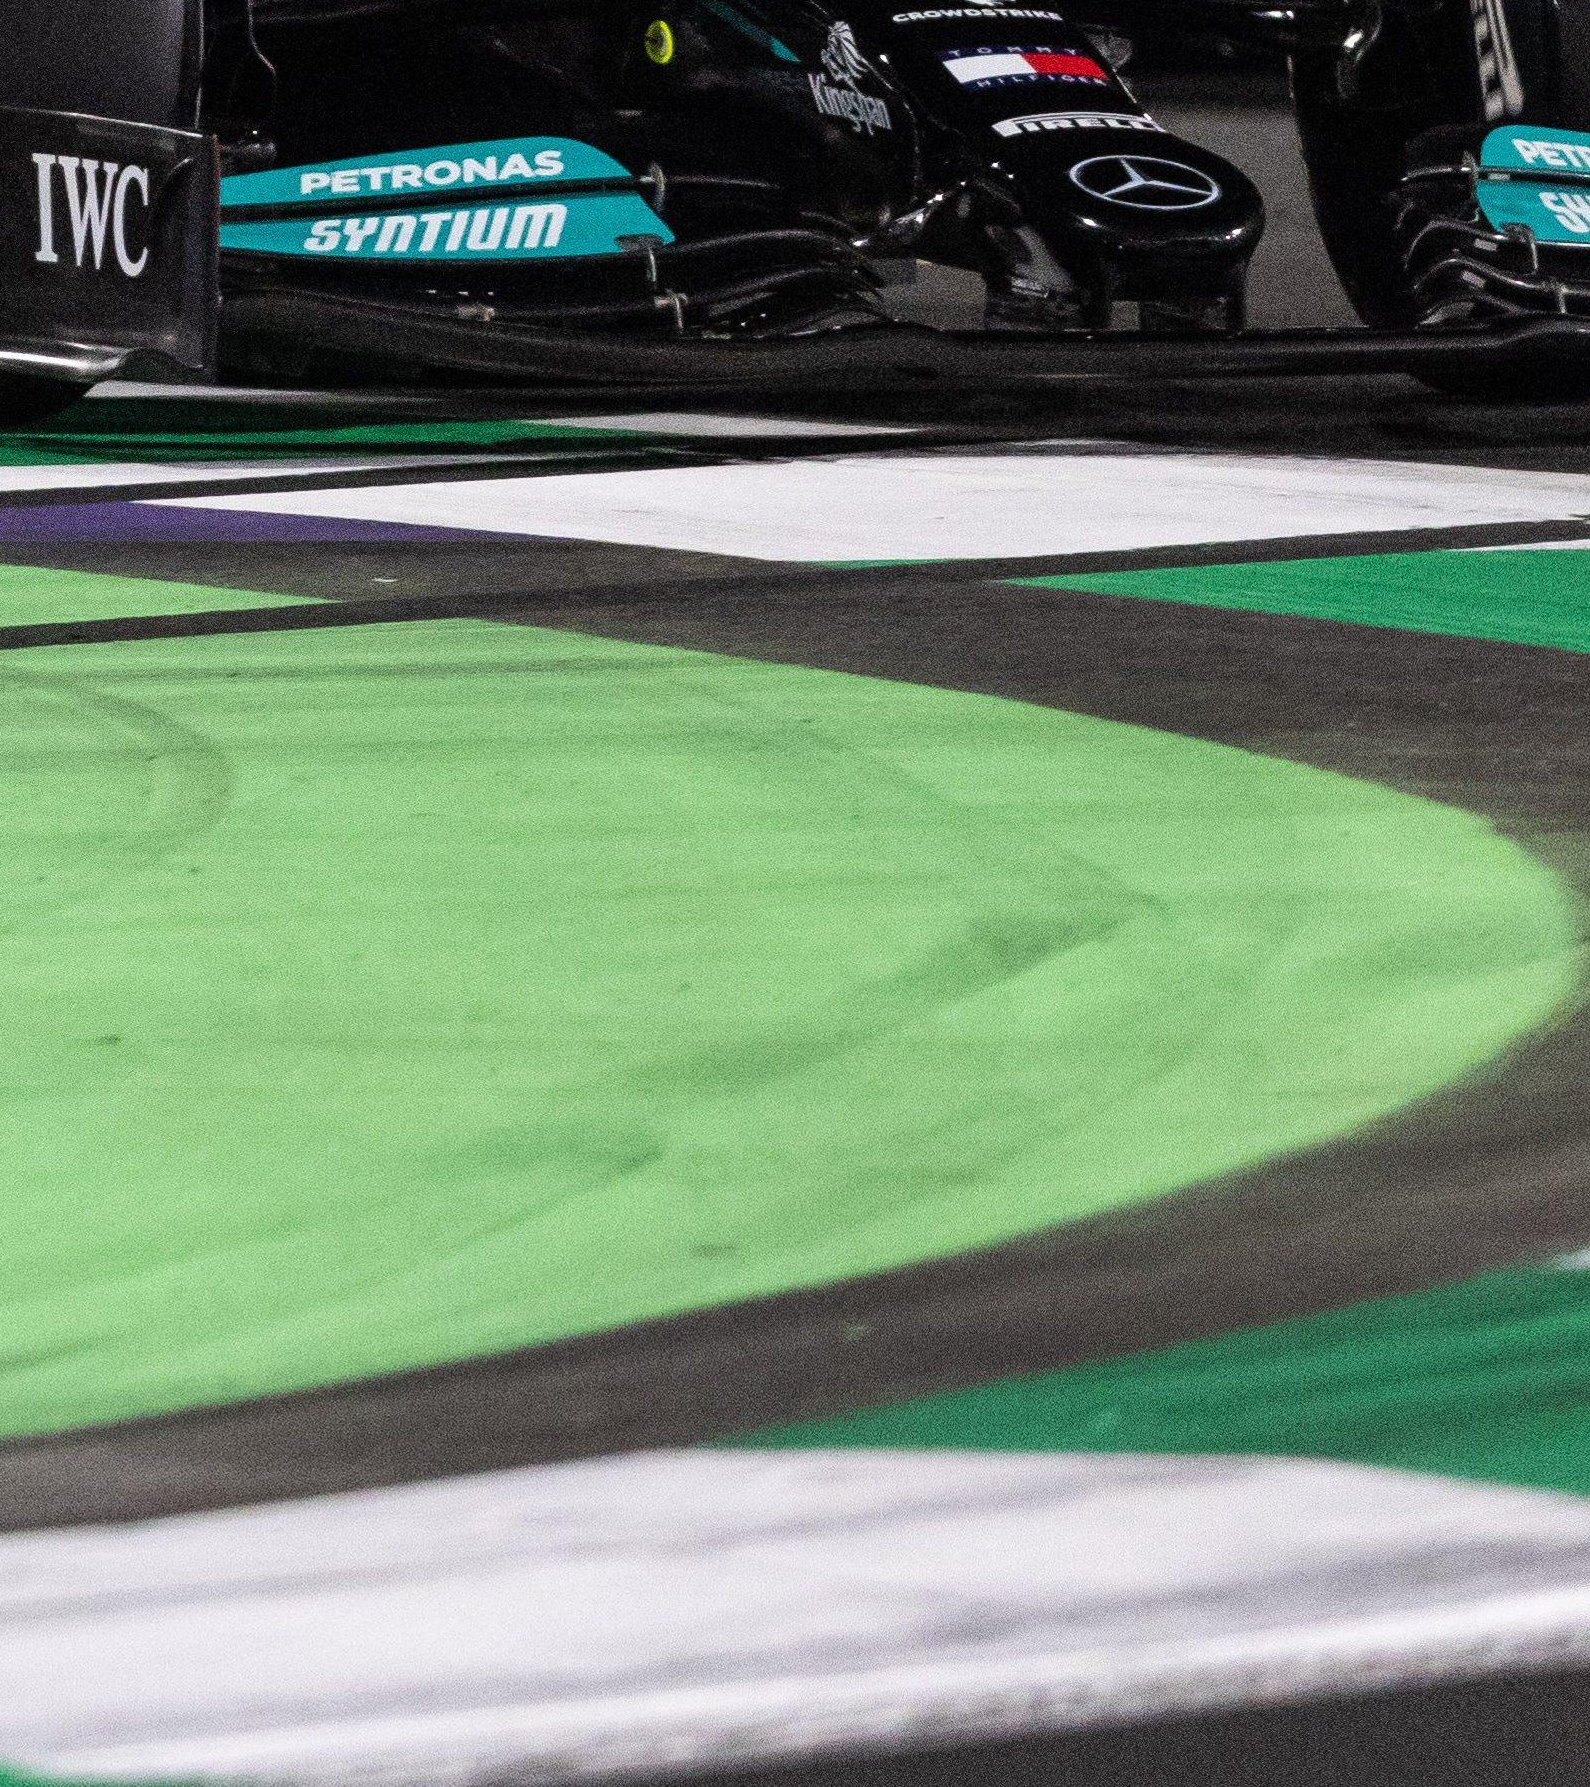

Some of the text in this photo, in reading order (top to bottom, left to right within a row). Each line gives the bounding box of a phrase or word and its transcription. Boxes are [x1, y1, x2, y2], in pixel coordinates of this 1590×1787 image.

[892, 8, 1064, 23] CROWDSTRIKE
[947, 45, 1078, 58] TOMMY
[808, 72, 892, 137] Kingspan
[299, 149, 566, 198] PETRONAS
[32, 150, 151, 277] IWC
[301, 203, 568, 255] SYNTIUM
